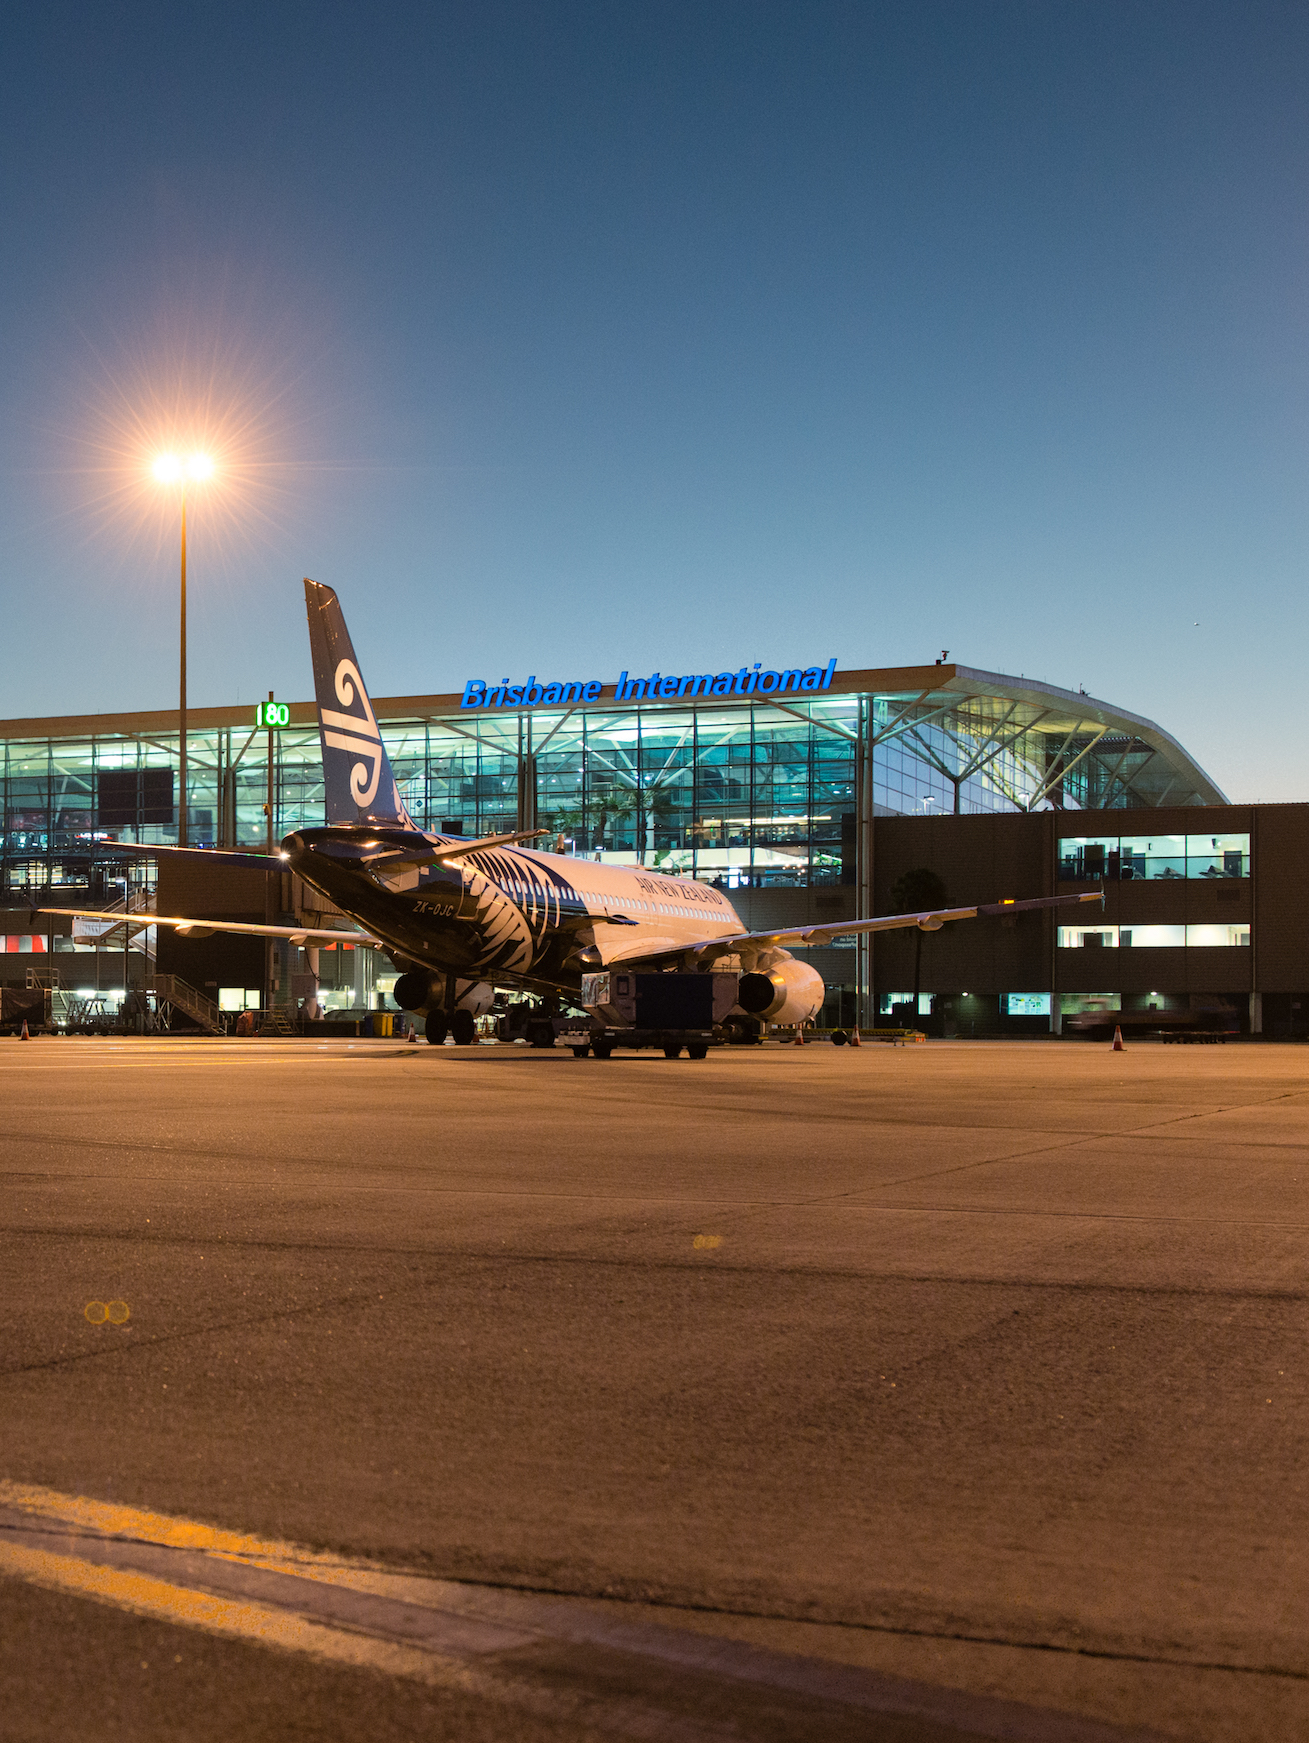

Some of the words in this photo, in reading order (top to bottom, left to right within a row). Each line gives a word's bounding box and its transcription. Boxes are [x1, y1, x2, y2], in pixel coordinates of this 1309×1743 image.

[461, 675, 602, 709] Brisbane
[614, 658, 838, 701] International
[634, 875, 658, 895] AIR
[652, 879, 680, 898] NEW
[675, 883, 723, 905] ZEALAND
[412, 900, 454, 917] ZK-OJC
